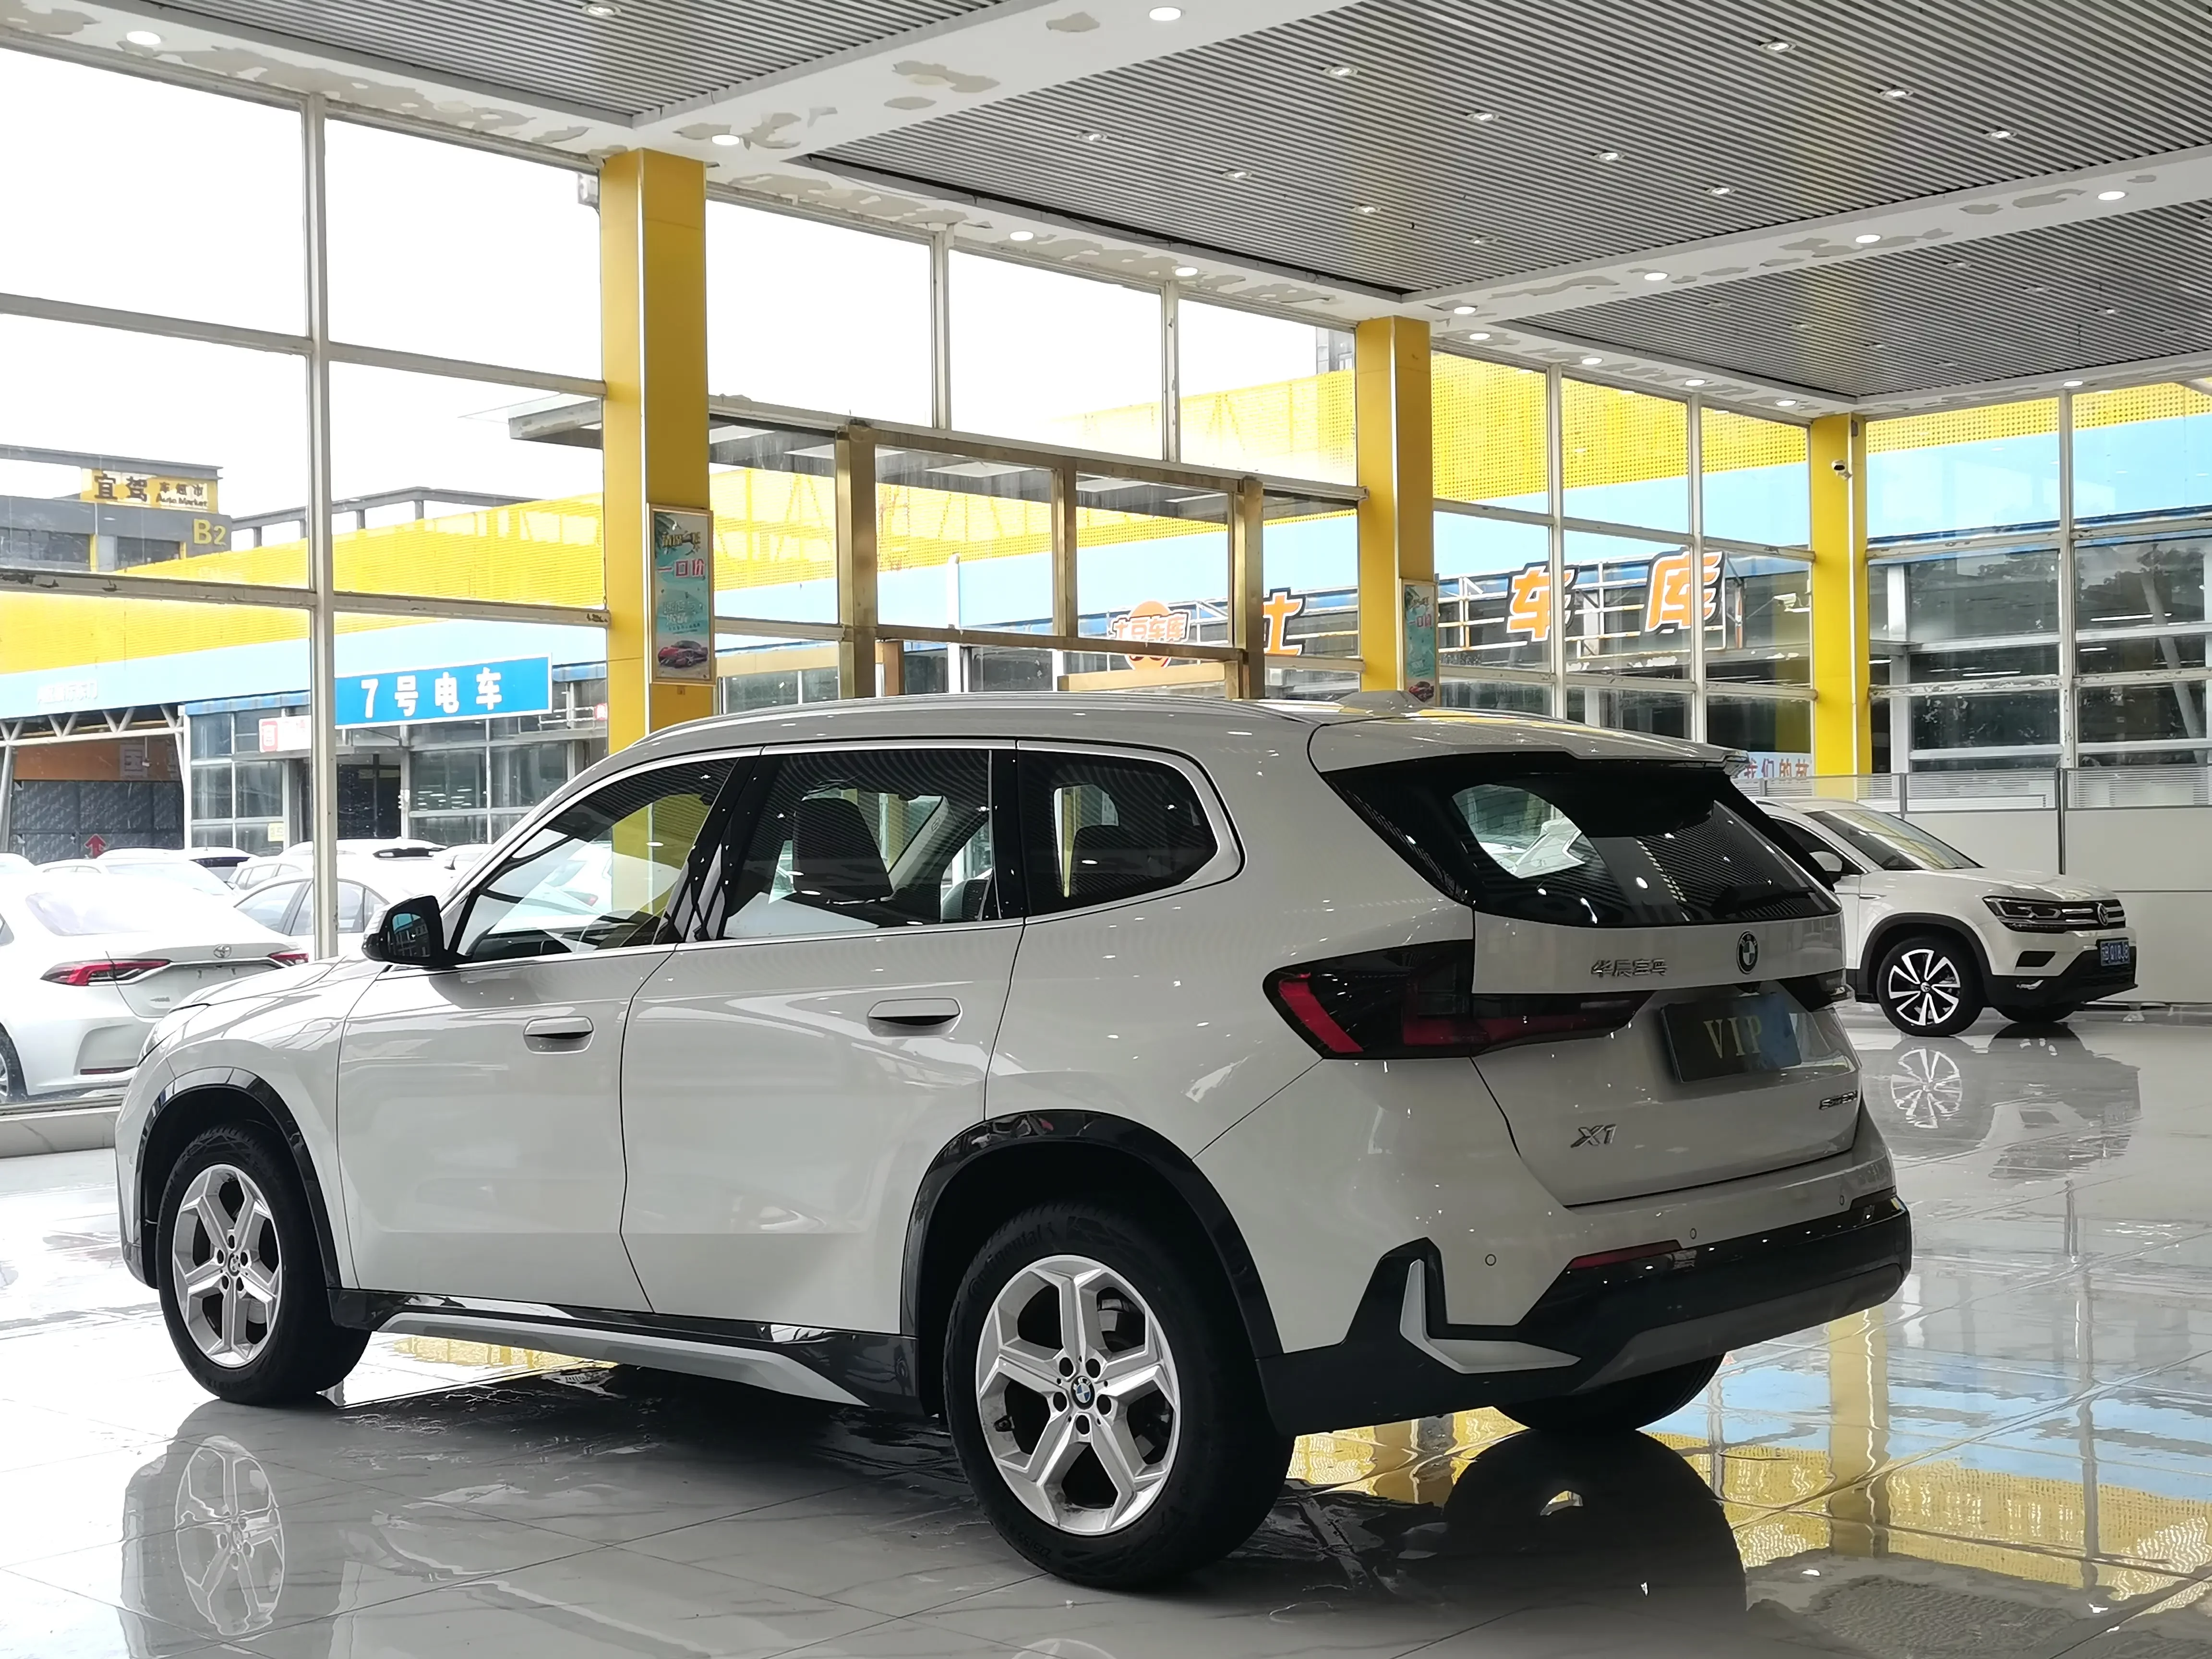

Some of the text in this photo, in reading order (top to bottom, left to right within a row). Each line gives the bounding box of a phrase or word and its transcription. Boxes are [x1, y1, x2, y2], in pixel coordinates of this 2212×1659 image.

[94, 470, 147, 502] 宜驾
[193, 518, 227, 546] B2
[361, 666, 502, 718] 7号电车
[1590, 958, 1669, 978] 华晨宝马
[1703, 1015, 1762, 1059] VIP
[1570, 1124, 1617, 1148] X1
